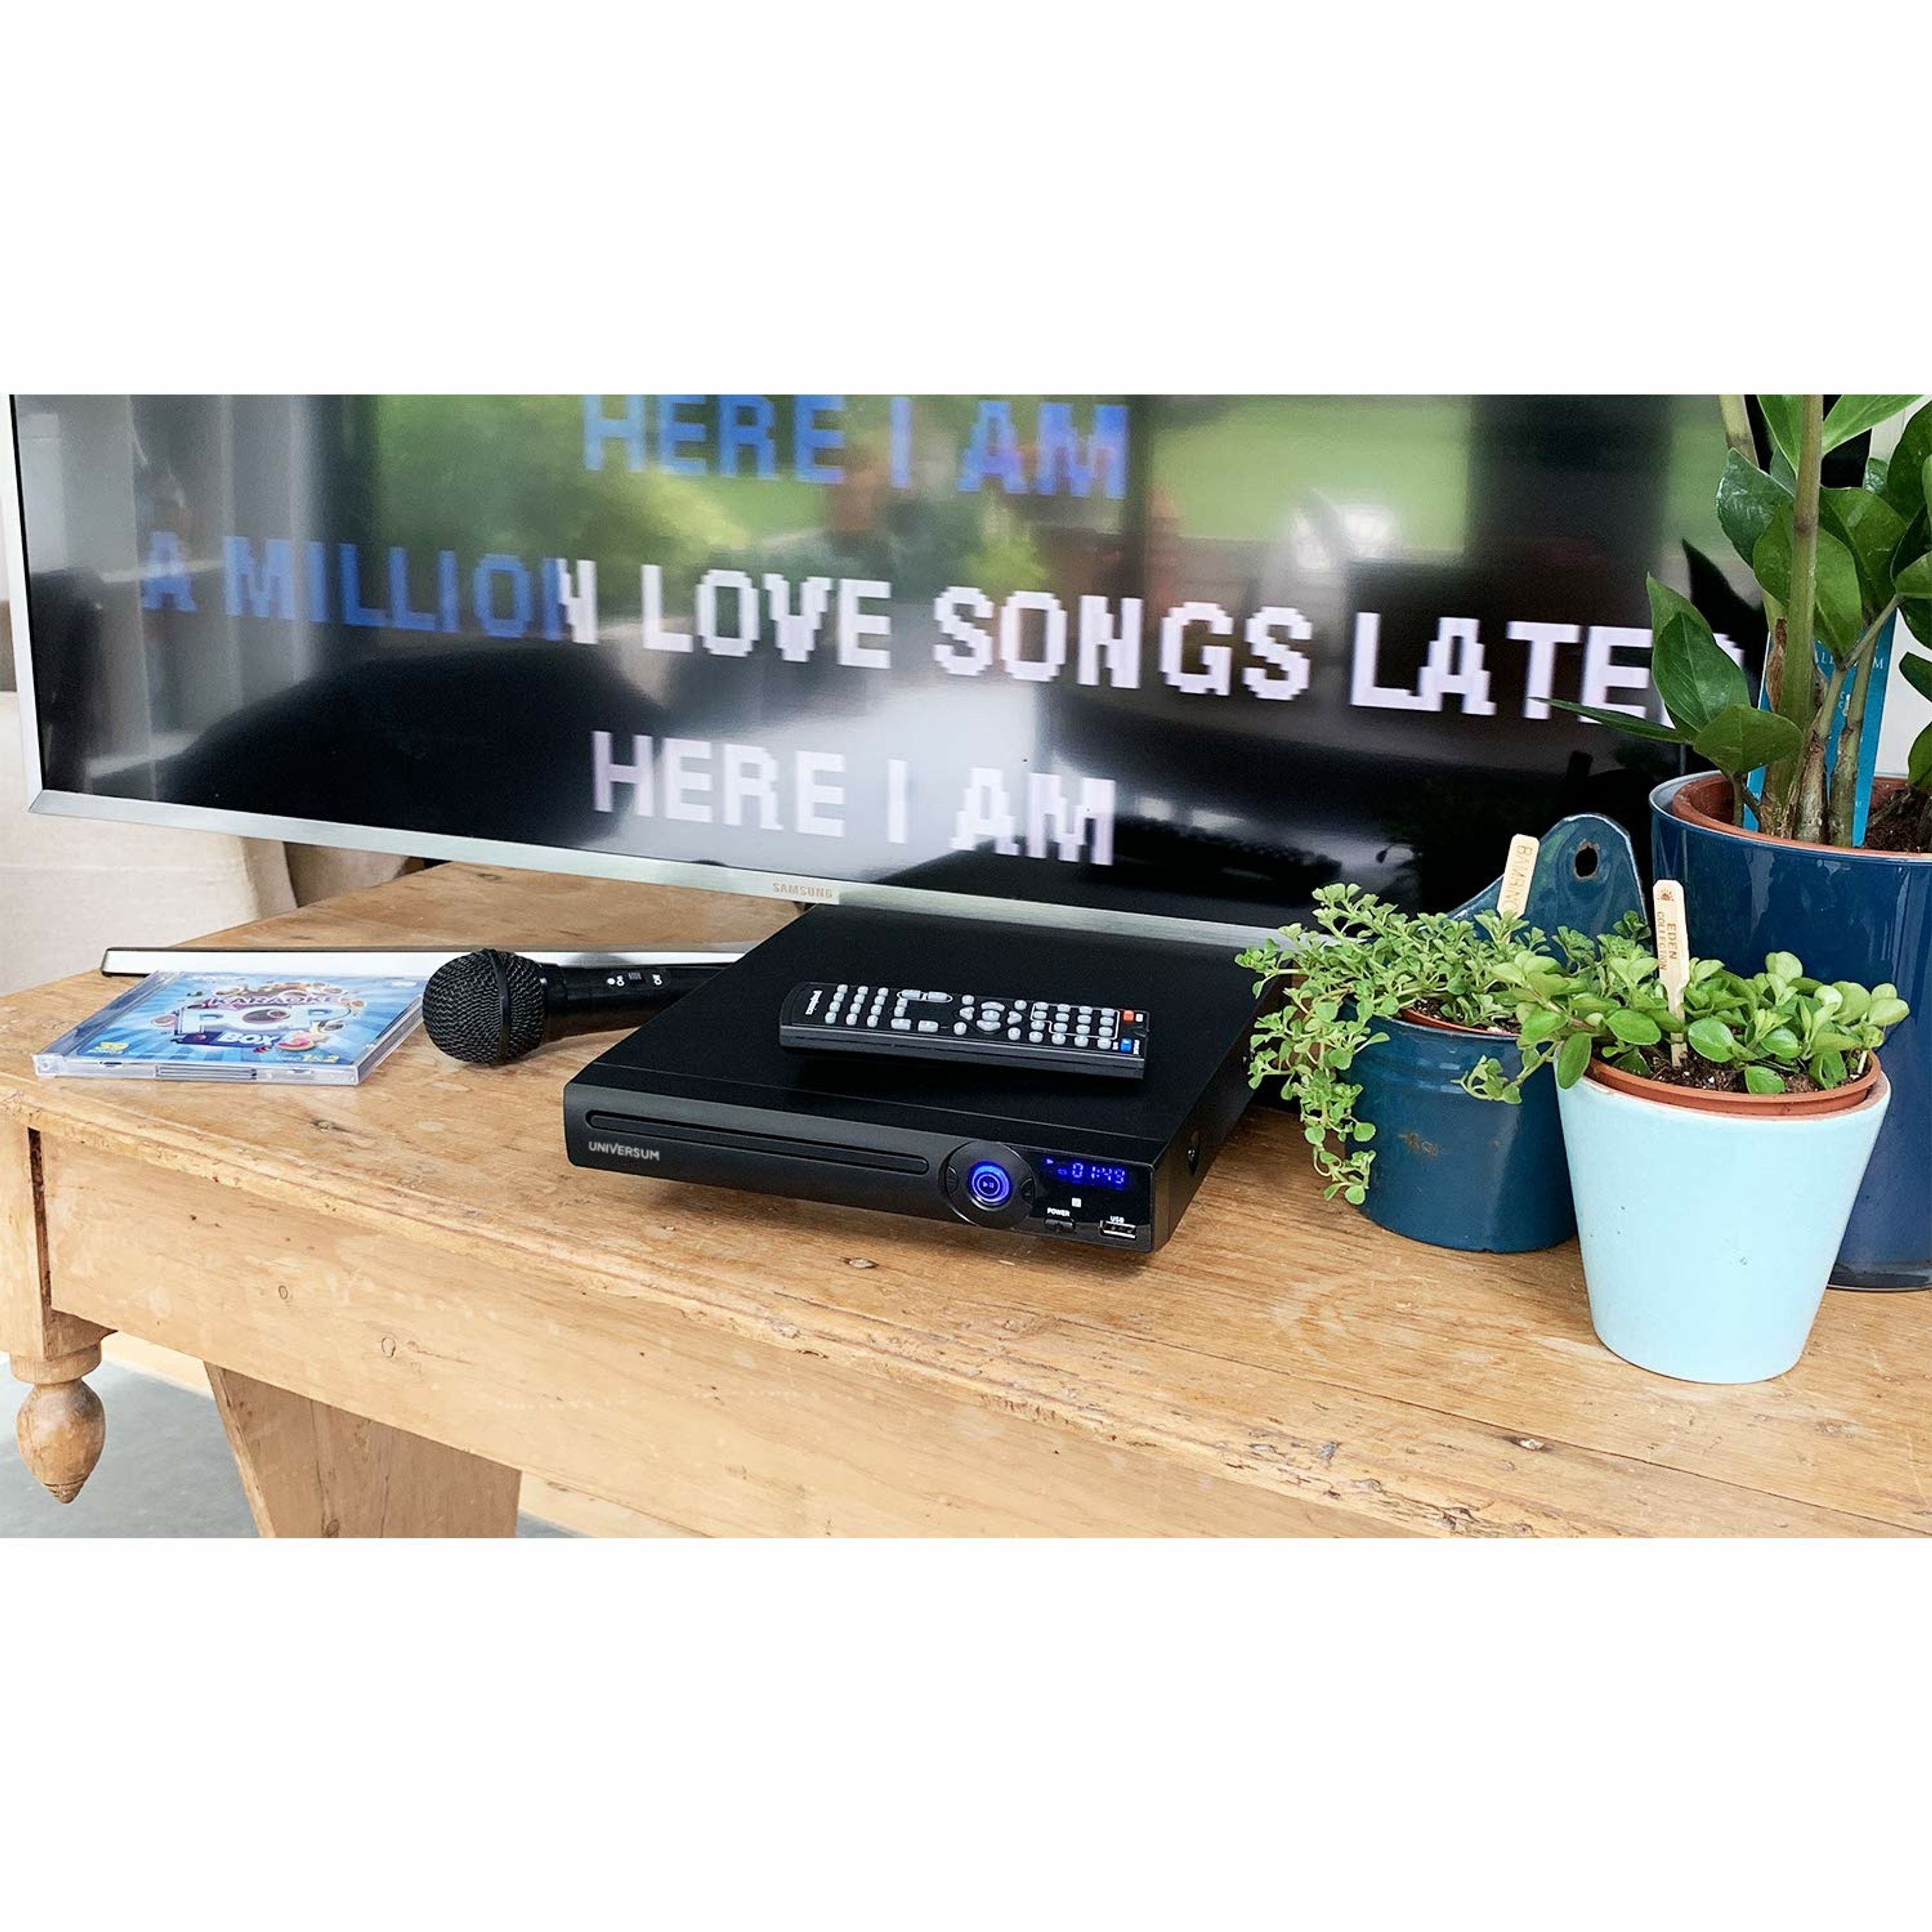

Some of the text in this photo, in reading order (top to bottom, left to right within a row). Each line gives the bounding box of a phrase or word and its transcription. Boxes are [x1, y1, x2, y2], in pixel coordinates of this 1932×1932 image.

[580, 395, 1128, 499] HERE I AM
[141, 531, 1744, 730] A MILLION LOVE SONGS LATE
[592, 730, 1116, 866] HERE I AM
[773, 882, 833, 898] SAMSUNG
[1667, 923, 1678, 960] EDEN
[178, 1005, 352, 1034] POP
[217, 1032, 278, 1046] BOX
[588, 1141, 660, 1160] UNIVERSUM
[1046, 1207, 1070, 1217] POWER
[1110, 1215, 1125, 1224] USB
